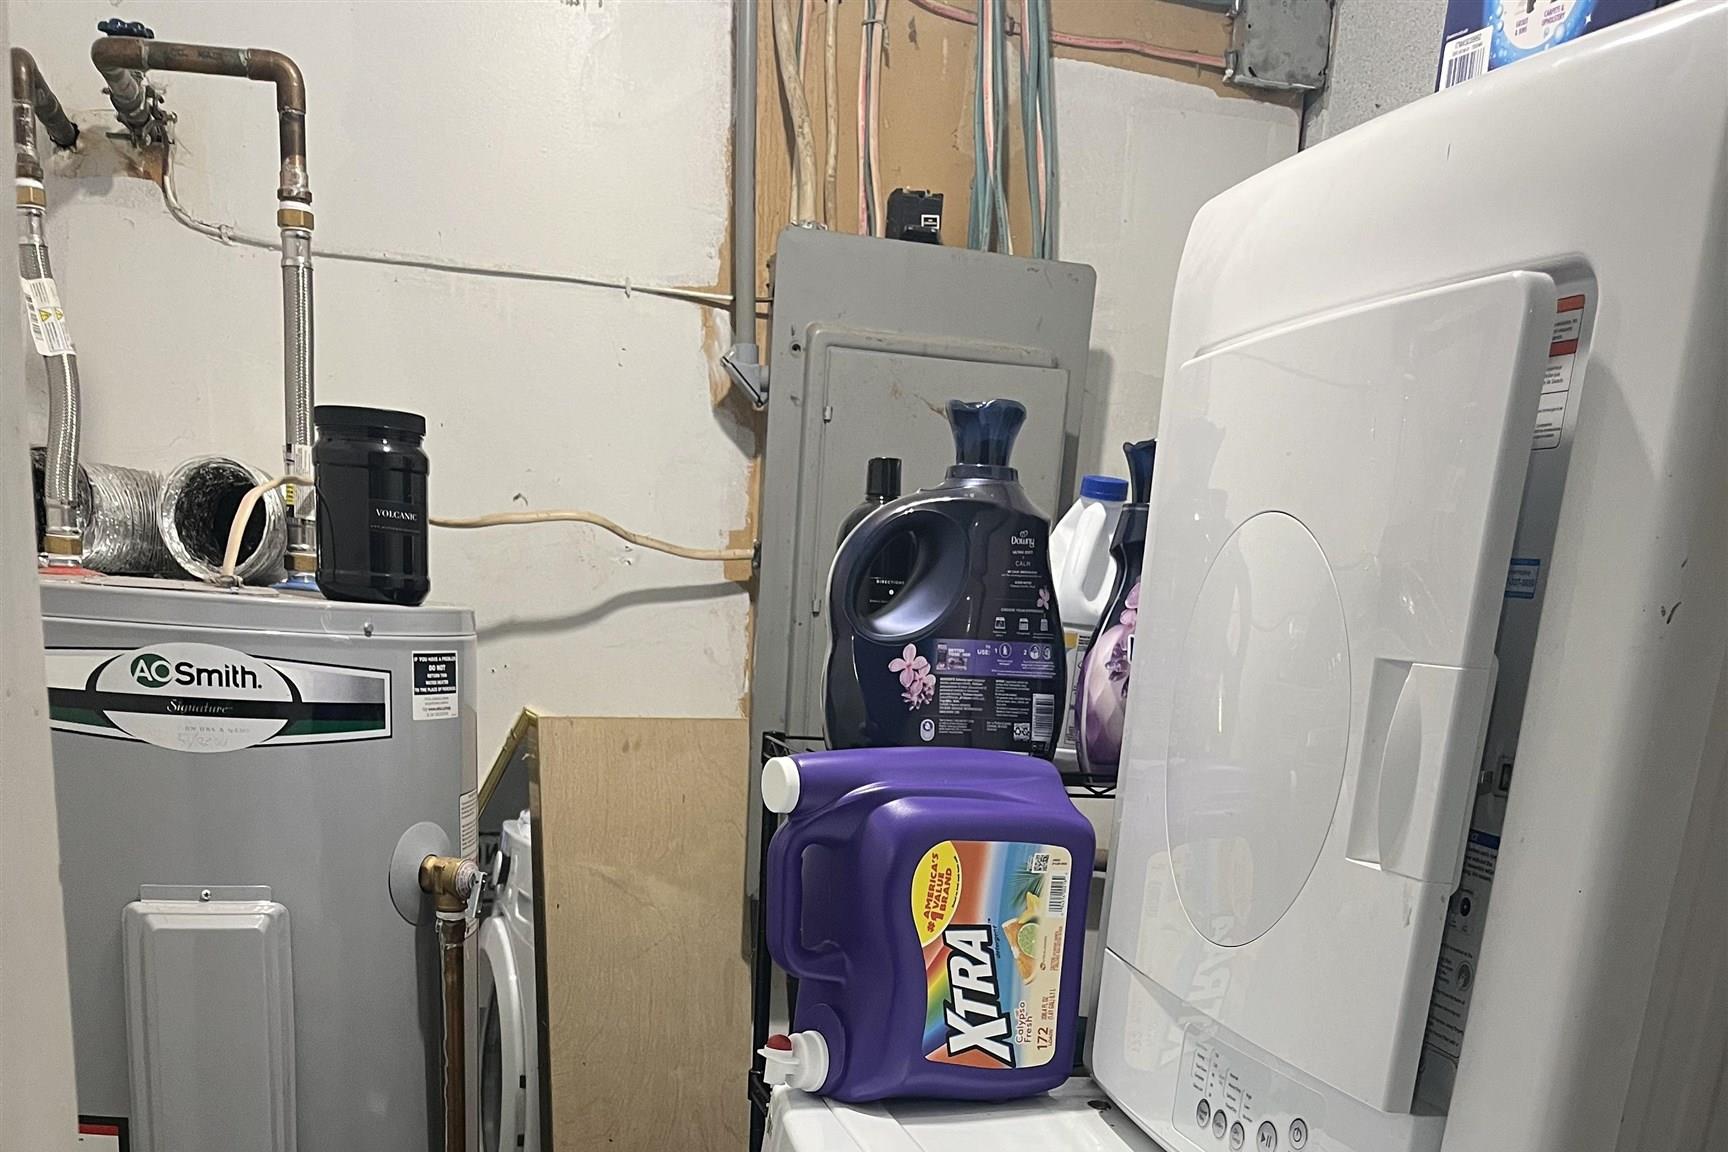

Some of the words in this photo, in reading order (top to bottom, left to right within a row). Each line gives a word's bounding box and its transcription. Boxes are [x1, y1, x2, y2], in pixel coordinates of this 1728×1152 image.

[376, 508, 417, 521] VOLCANIC
[1011, 536, 1035, 548] Downy
[166, 699, 229, 714] Signature
[923, 852, 941, 919] AMERICA'S
[933, 872, 946, 909] VALUE
[939, 867, 953, 912] BRAND
[945, 925, 1015, 1068] XTRA
[1016, 1001, 1026, 1044] Calypso
[1024, 1015, 1034, 1044] Fresh
[1037, 1027, 1051, 1051] 172
